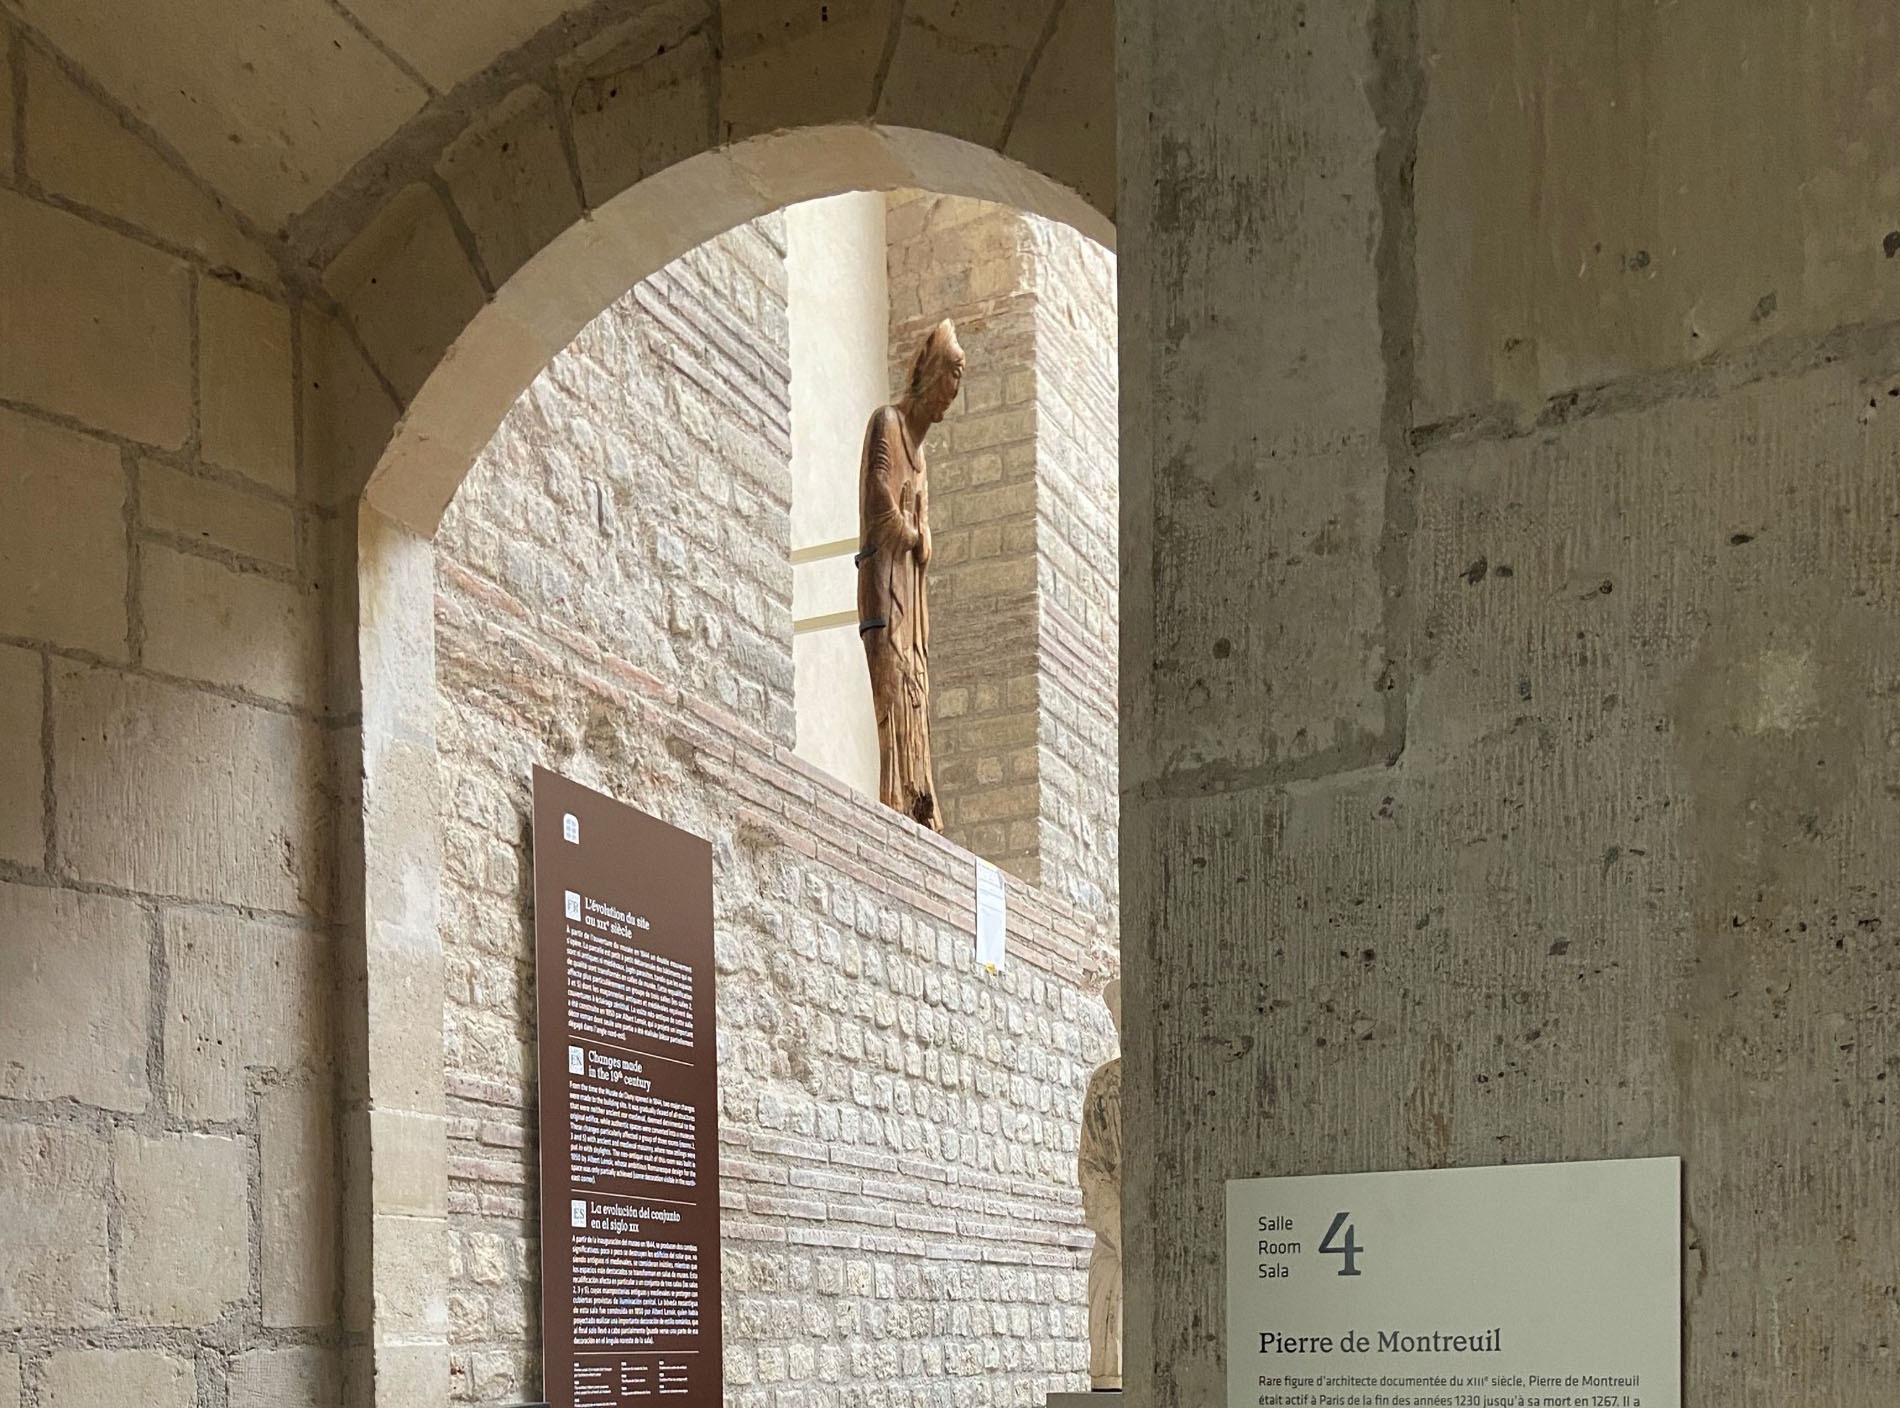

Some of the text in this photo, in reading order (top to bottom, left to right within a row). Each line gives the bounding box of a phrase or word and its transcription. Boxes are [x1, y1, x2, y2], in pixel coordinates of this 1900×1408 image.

[585, 897, 650, 930] L'évolution du site
[585, 916, 596, 927] au
[610, 922, 633, 940] siècle
[588, 1050, 643, 1073] Changes made
[588, 1065, 597, 1078] in
[597, 1067, 610, 1081] the
[623, 1075, 652, 1093] century
[590, 1201, 681, 1224] La evolución del conjunto
[1257, 1215, 1293, 1232] Salle
[590, 1219, 601, 1229] en
[601, 1217, 610, 1230] el
[610, 1218, 629, 1235] siglo
[1258, 1239, 1301, 1255] Room
[1317, 1211, 1364, 1276] 4
[1258, 1262, 1289, 1279] Sala
[1258, 1327, 1502, 1354] Pierre de Montreuil
